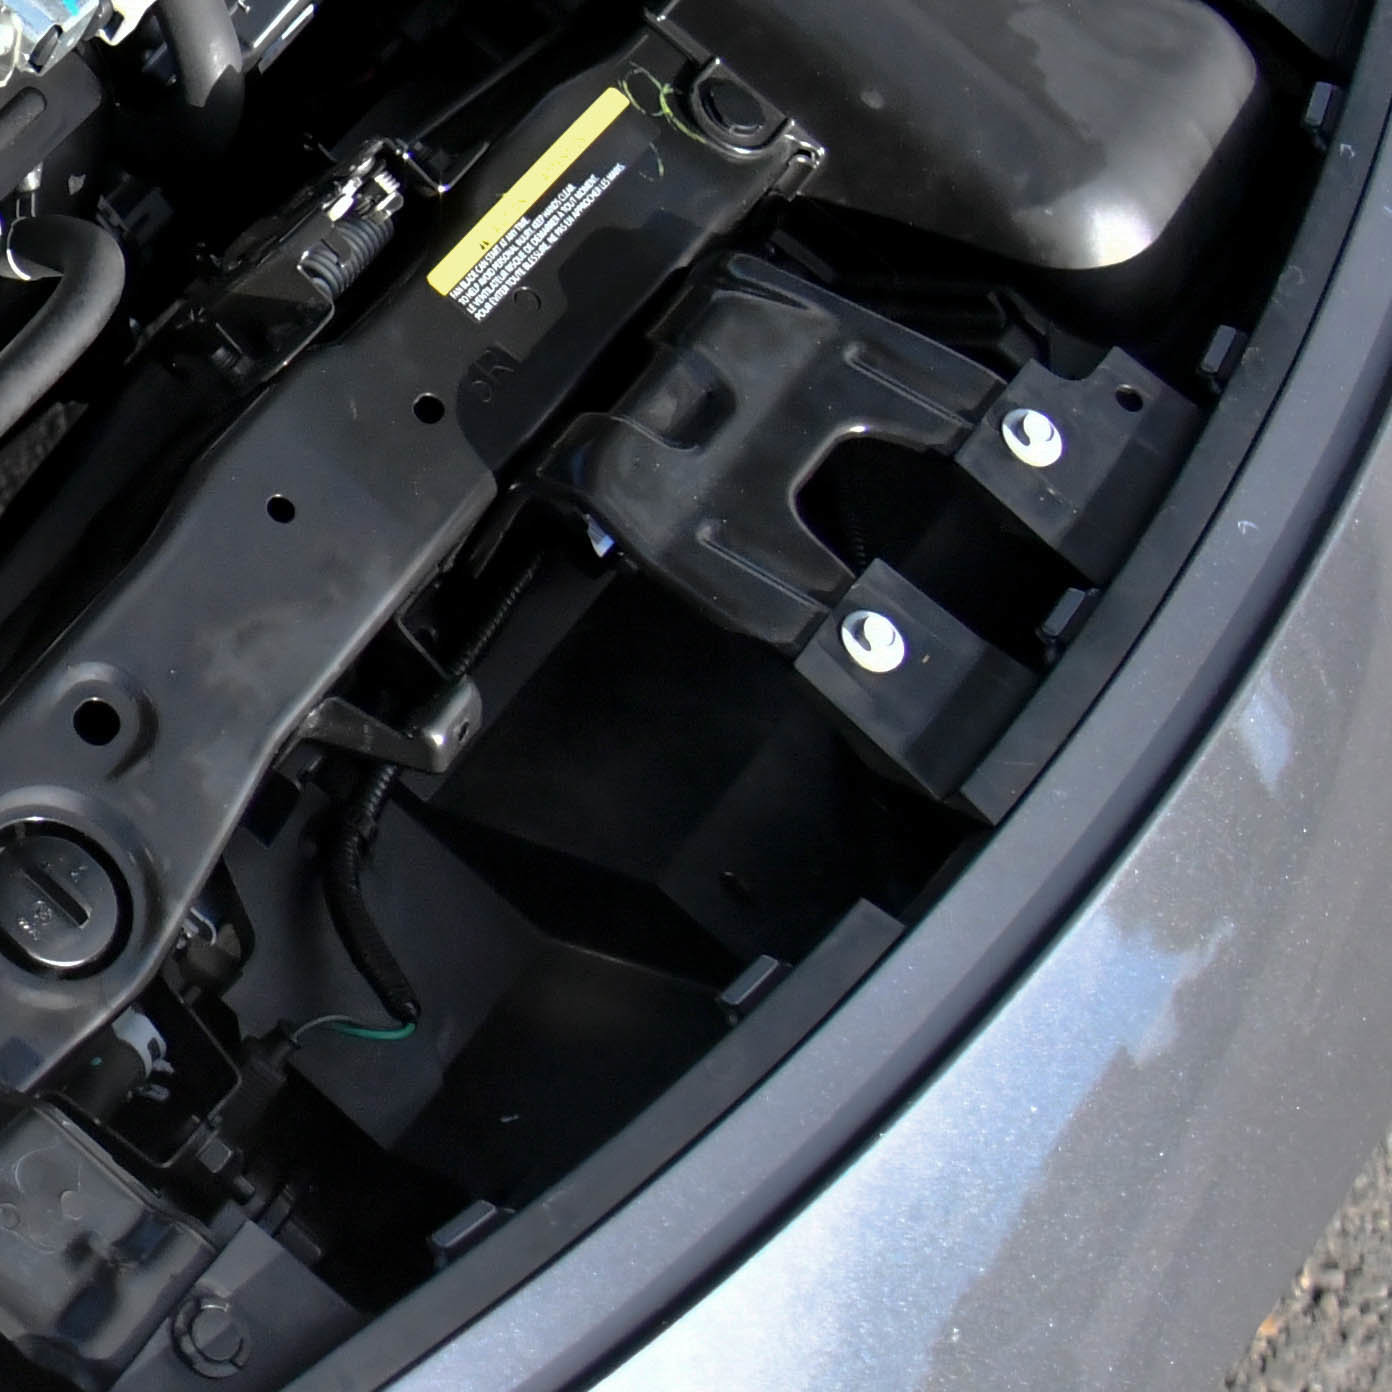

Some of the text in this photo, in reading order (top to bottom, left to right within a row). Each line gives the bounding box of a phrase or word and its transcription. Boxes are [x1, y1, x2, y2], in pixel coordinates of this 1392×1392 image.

[450, 285, 463, 299] FAN
[460, 270, 477, 288] BLADE
[474, 259, 488, 273] CAN
[485, 245, 501, 262] START
[498, 238, 508, 247] AT
[504, 228, 518, 241] ANY
[458, 295, 469, 306] TO
[466, 283, 481, 298] HELP
[477, 268, 495, 286] AVOID
[492, 243, 518, 271] PERSONAL
[530, 214, 545, 229] KEEP
[542, 198, 561, 217] HANDS
[466, 303, 476, 313] LE
[472, 269, 508, 306] VENTILATEUR
[523, 242, 533, 253] DE
[560, 196, 577, 213] TOUT
[474, 301, 492, 319] POUR
[505, 266, 525, 287] TOUTE
[546, 233, 557, 244] NE
[554, 222, 567, 236] PAS
[563, 214, 574, 226] EN
[570, 186, 601, 218] APPROCHER
[598, 178, 609, 189] LES
